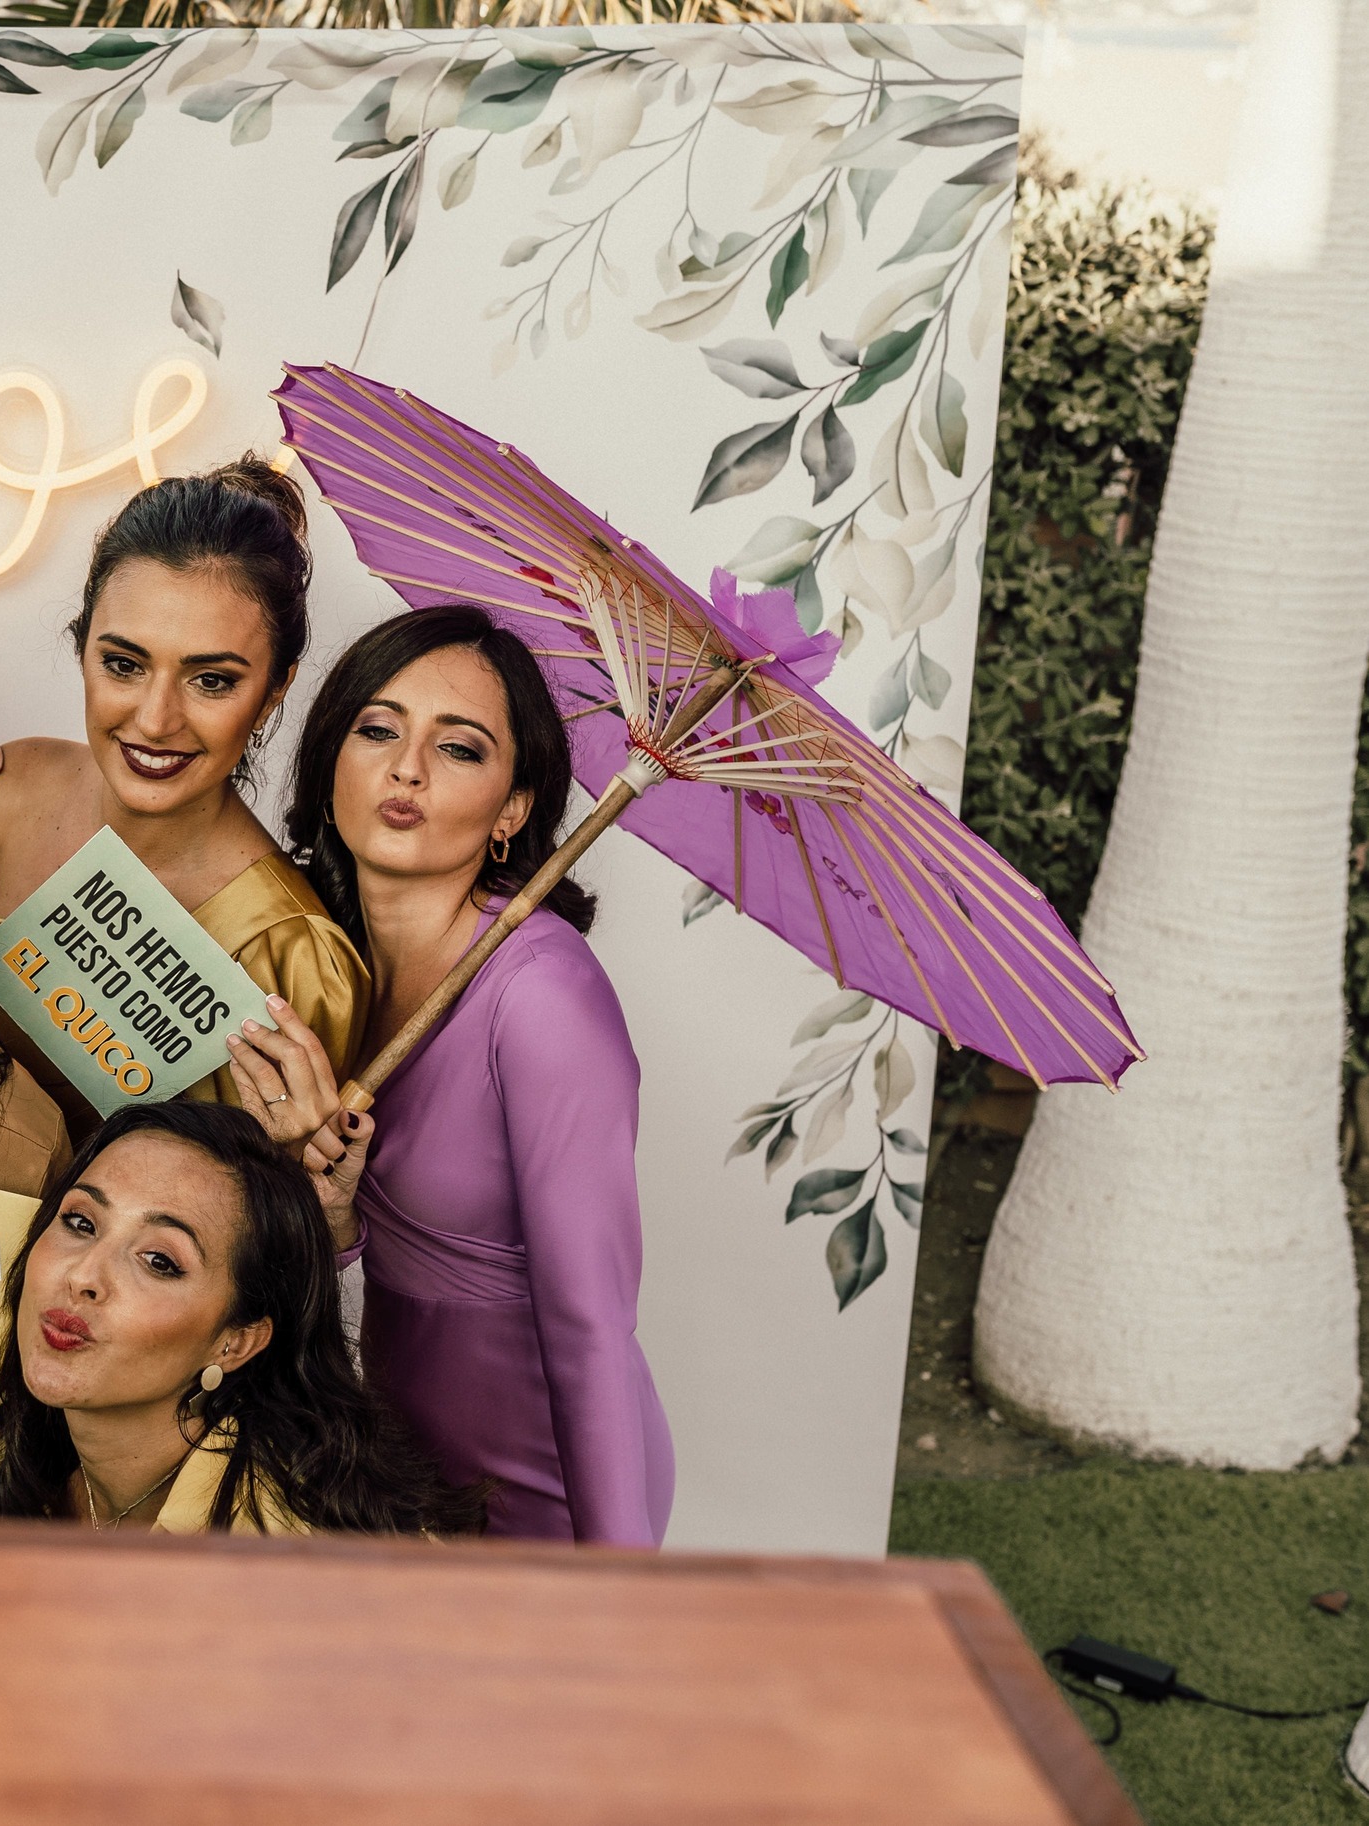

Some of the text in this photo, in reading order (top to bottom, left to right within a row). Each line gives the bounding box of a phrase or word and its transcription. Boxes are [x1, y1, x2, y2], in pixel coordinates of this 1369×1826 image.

[1, 936, 154, 1096] EL QUICO
[39, 903, 193, 1064] PUESTO COMO
[72, 870, 230, 1035] NOS HEMOS
